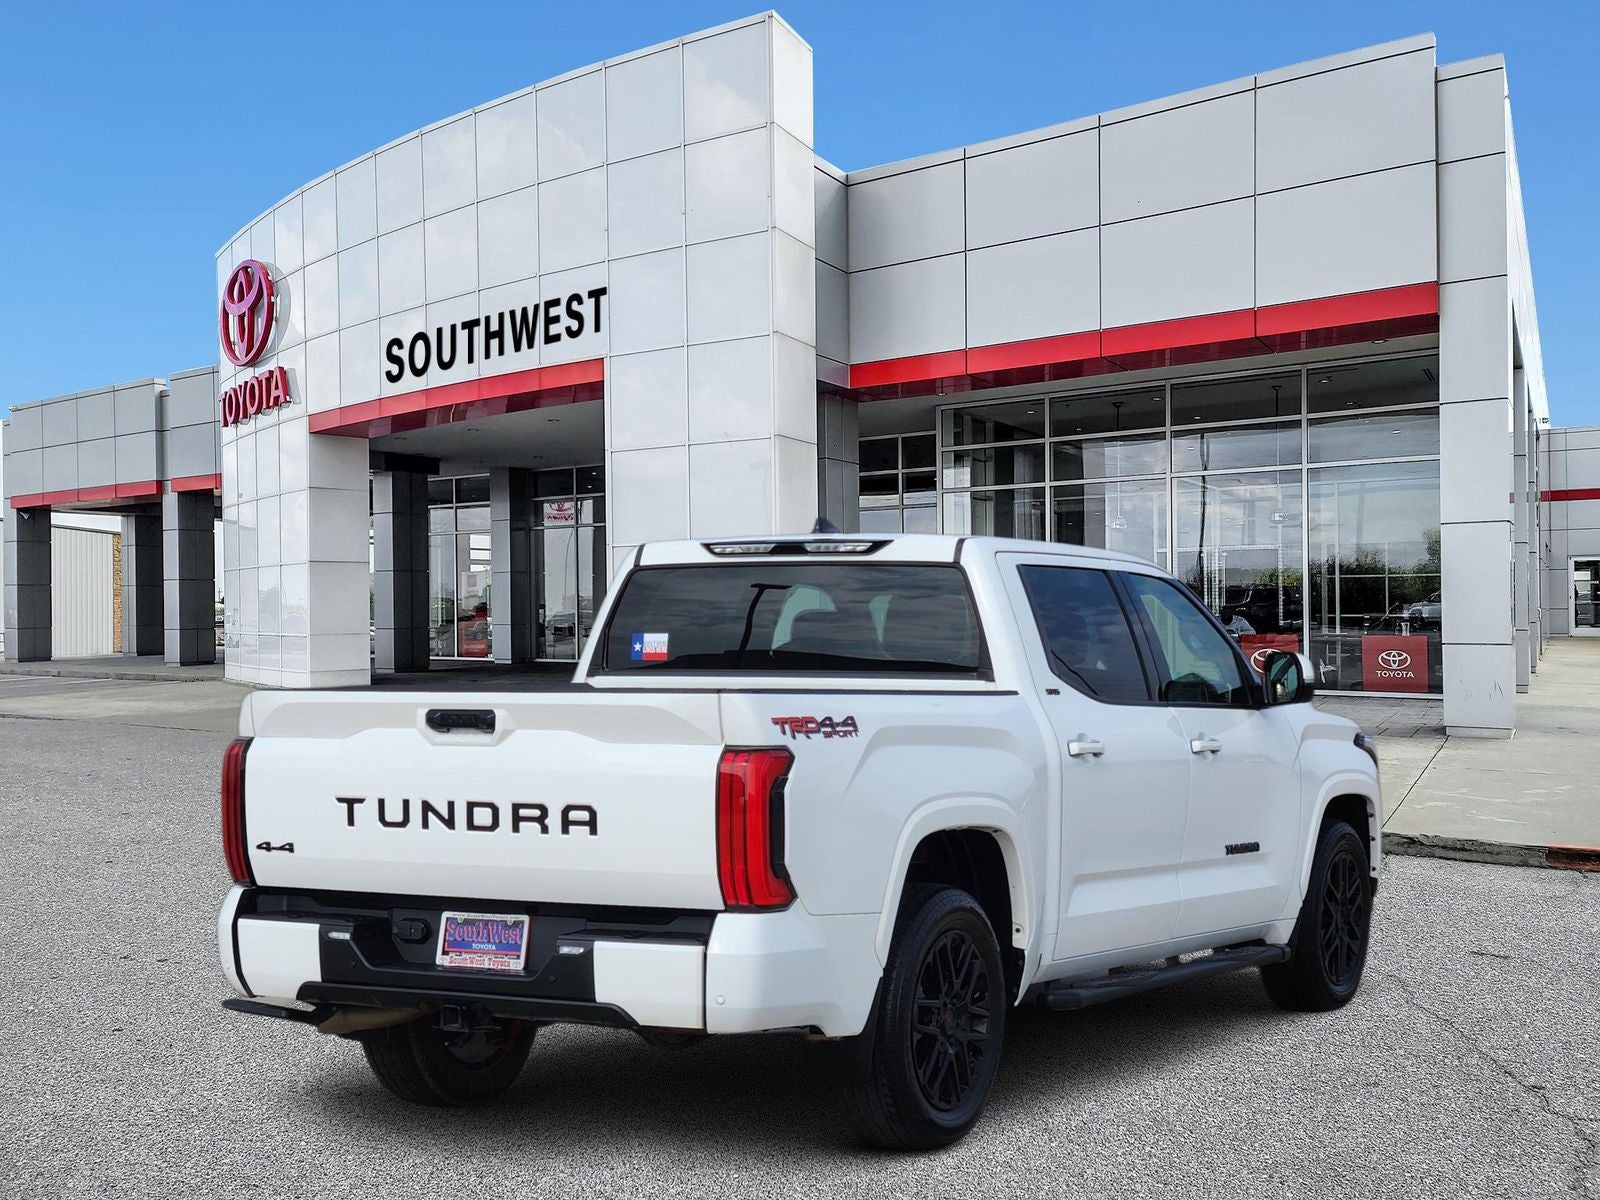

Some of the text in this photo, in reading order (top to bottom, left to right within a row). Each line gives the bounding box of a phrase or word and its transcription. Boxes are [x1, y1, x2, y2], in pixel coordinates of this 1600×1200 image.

[385, 286, 608, 383] SOUTHWEST
[218, 366, 291, 427] TOYOTA
[771, 716, 821, 740] TRD
[822, 730, 860, 739] SPORT
[336, 797, 598, 837] TUNDRA
[488, 957, 511, 968] Toyota
